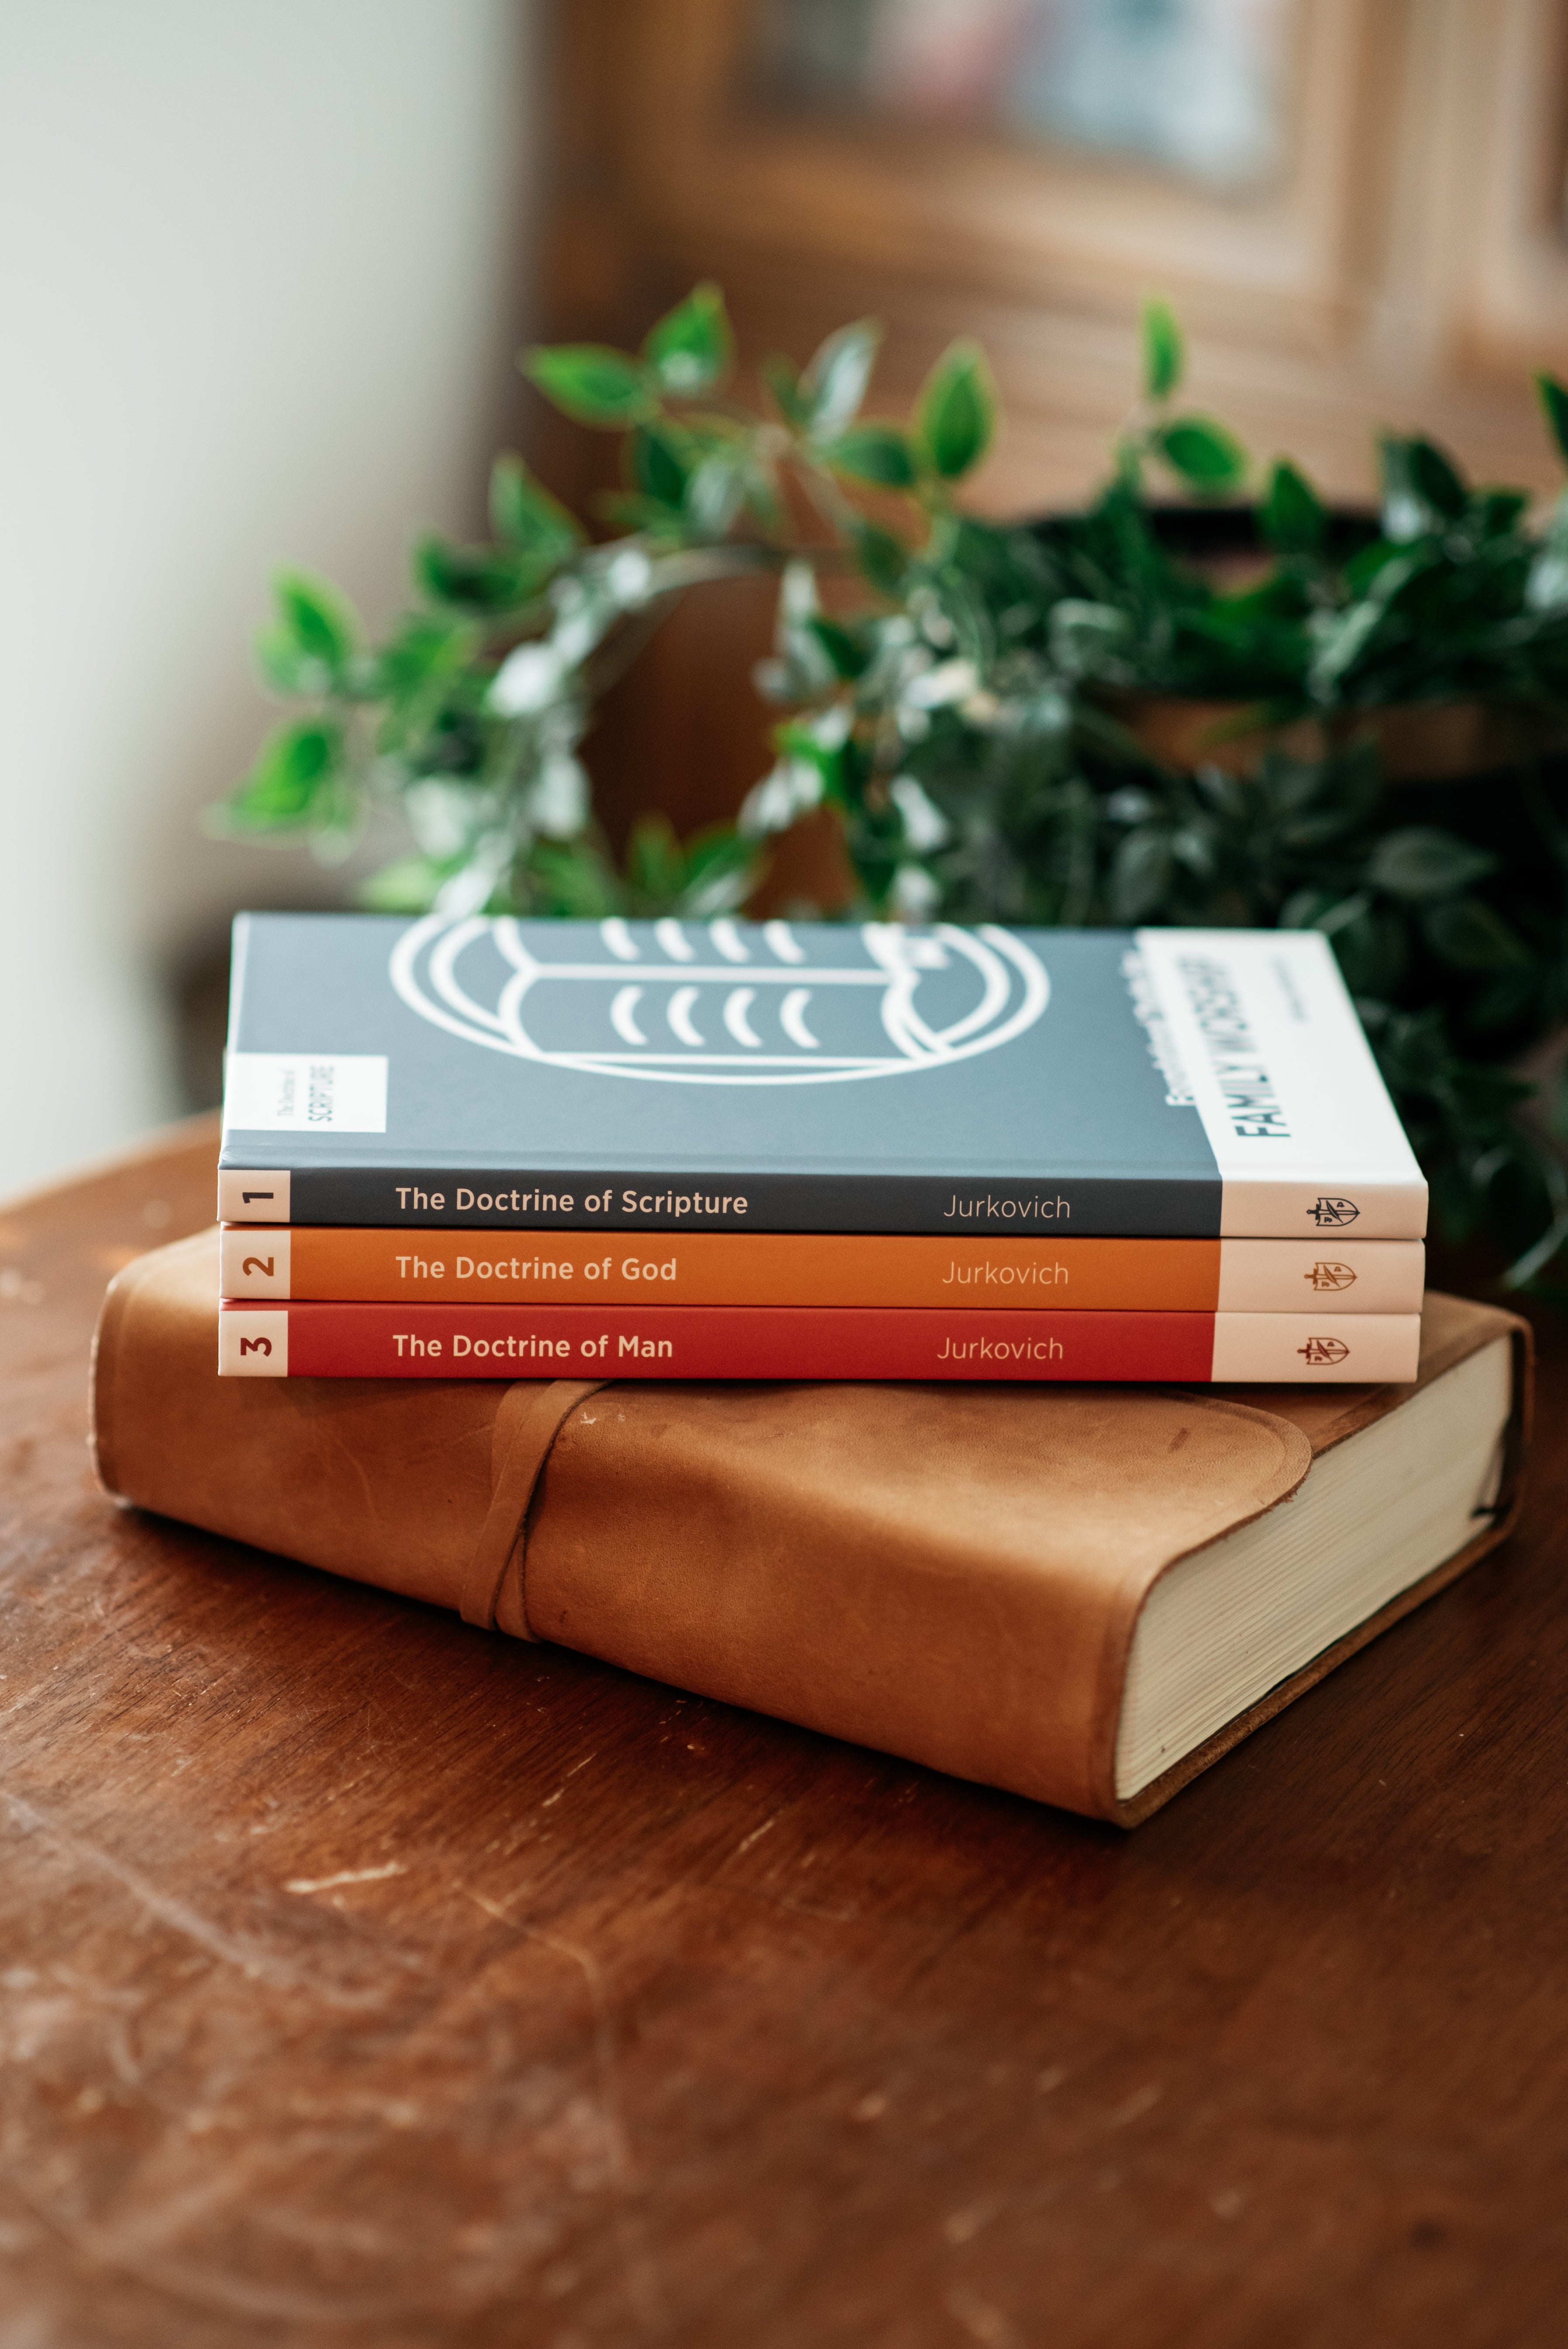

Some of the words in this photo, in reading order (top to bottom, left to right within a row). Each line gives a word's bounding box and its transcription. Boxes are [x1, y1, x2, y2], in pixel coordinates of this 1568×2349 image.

[1214, 1064, 1291, 1137] FAMILY
[242, 1192, 274, 1204] 1
[395, 1187, 445, 1210] The
[457, 1188, 574, 1211] Doctrine
[585, 1190, 613, 1211] of
[622, 1190, 748, 1217] Scripture
[944, 1195, 1070, 1218] Jurkovich
[243, 1257, 274, 1276] 2
[395, 1256, 445, 1278] The
[456, 1257, 573, 1280] Doctrine
[584, 1257, 612, 1280] of
[621, 1258, 676, 1280] God
[942, 1262, 1068, 1284] Jurkovich
[241, 1337, 272, 1357] 3
[393, 1335, 442, 1357] The
[453, 1335, 570, 1357] Doctrine
[581, 1335, 609, 1357] of
[619, 1335, 672, 1357] Man
[937, 1337, 1063, 1359] Jurkovich
